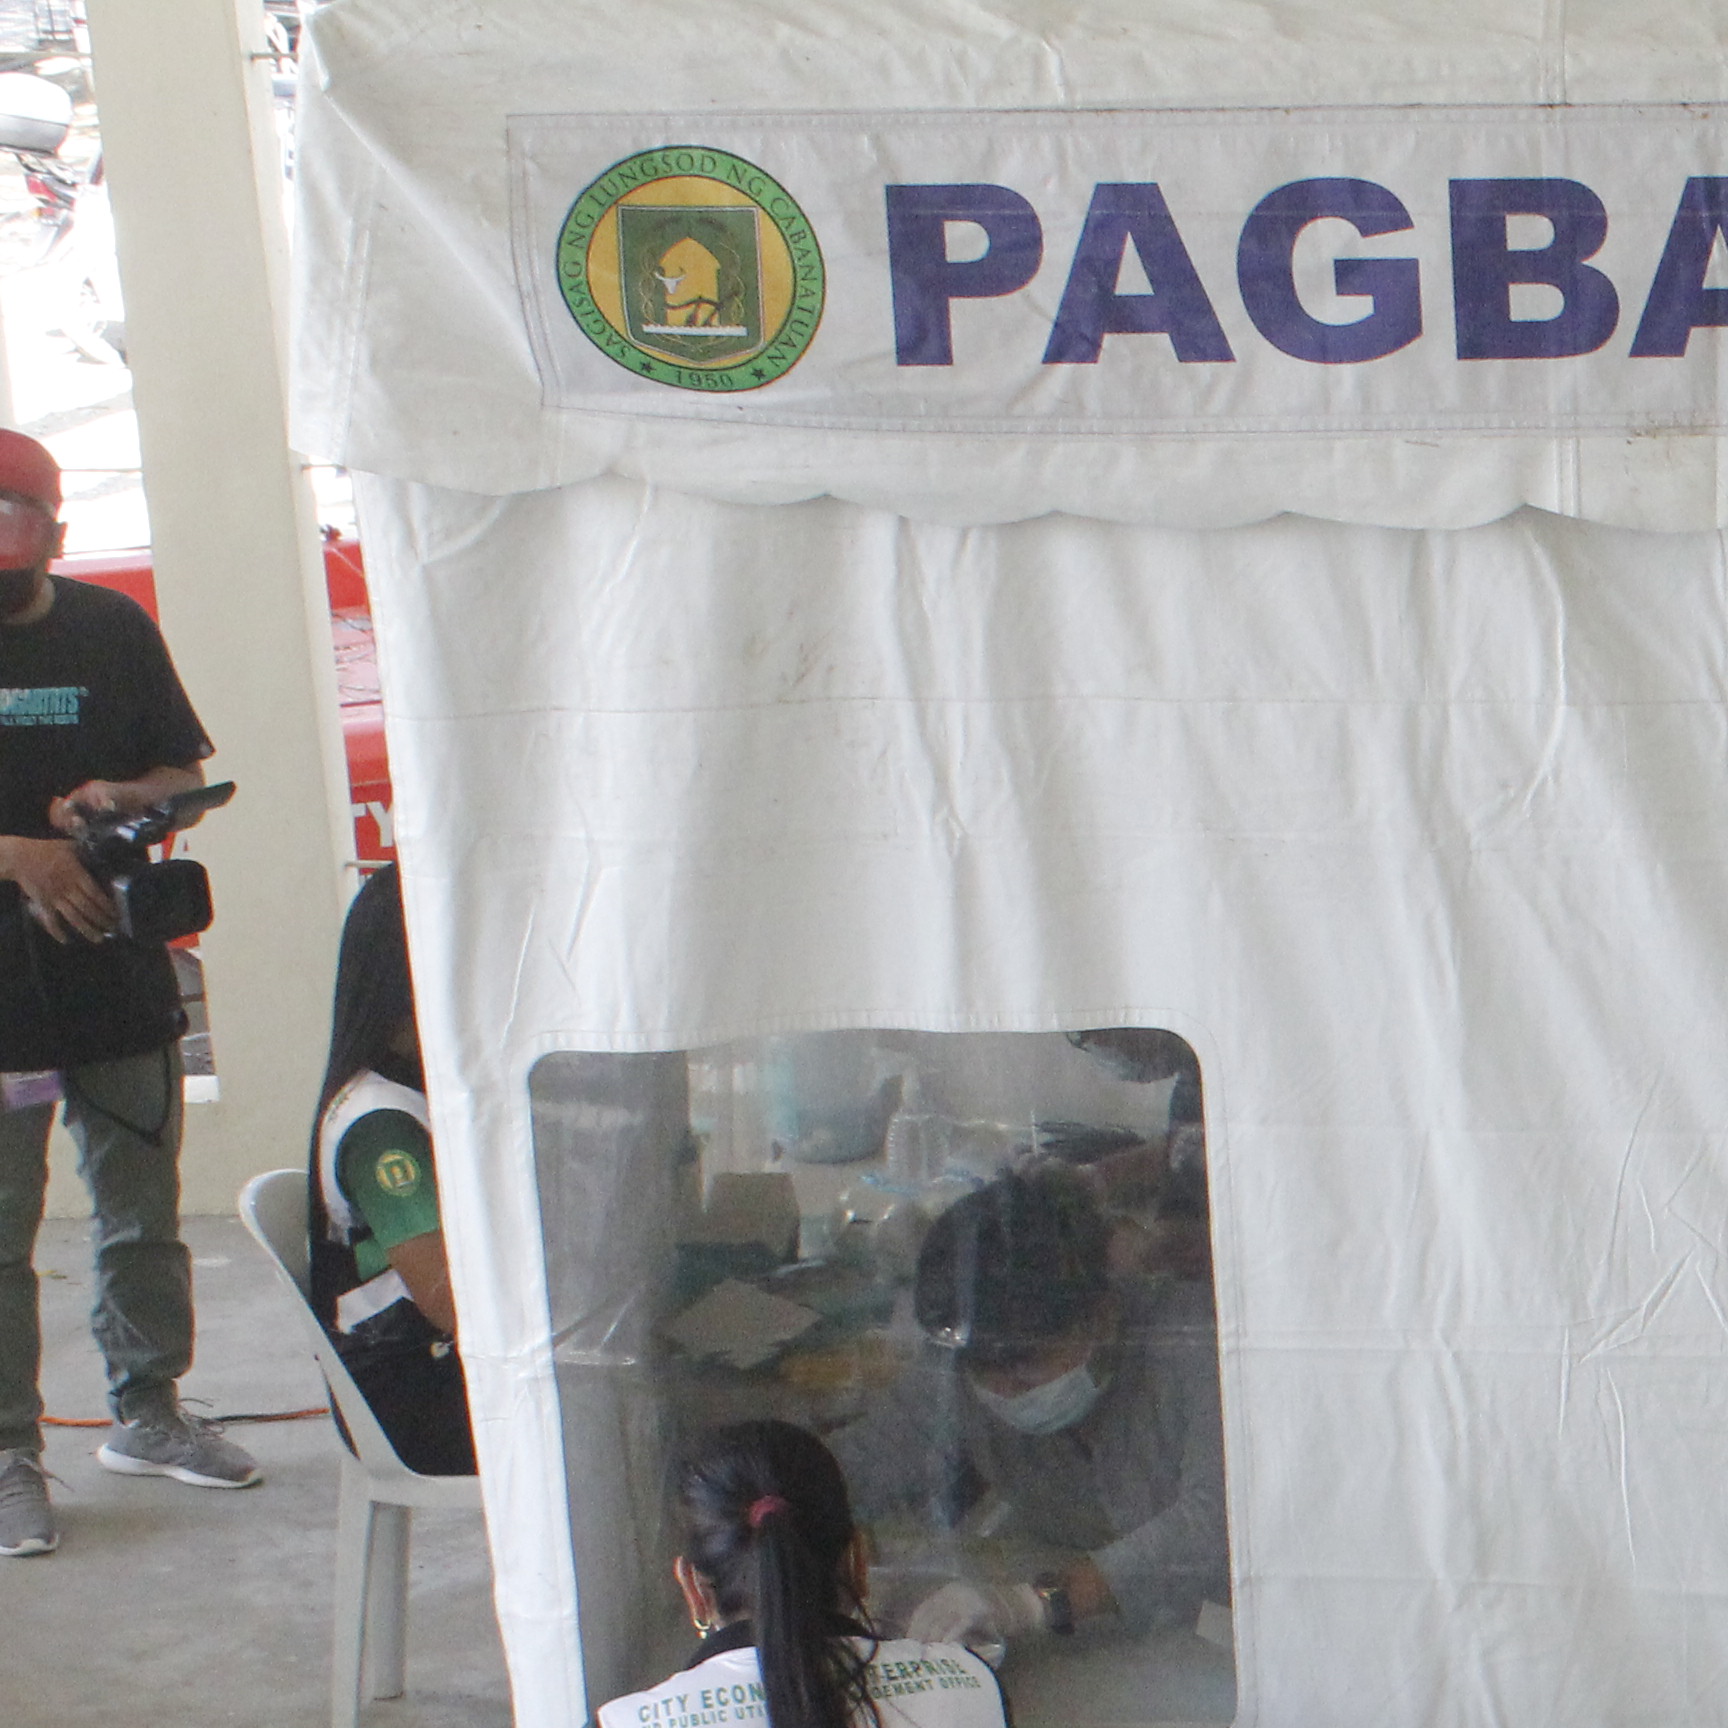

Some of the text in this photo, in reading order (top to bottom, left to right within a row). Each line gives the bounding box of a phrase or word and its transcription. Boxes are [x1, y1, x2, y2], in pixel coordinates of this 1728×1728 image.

[563, 152, 818, 368] SAGISAG NG LUNGSOD NG CABANATUAN
[676, 372, 734, 389] 1950
[939, 1676, 981, 1689] OFFICE
[638, 1694, 689, 1722] CITY
